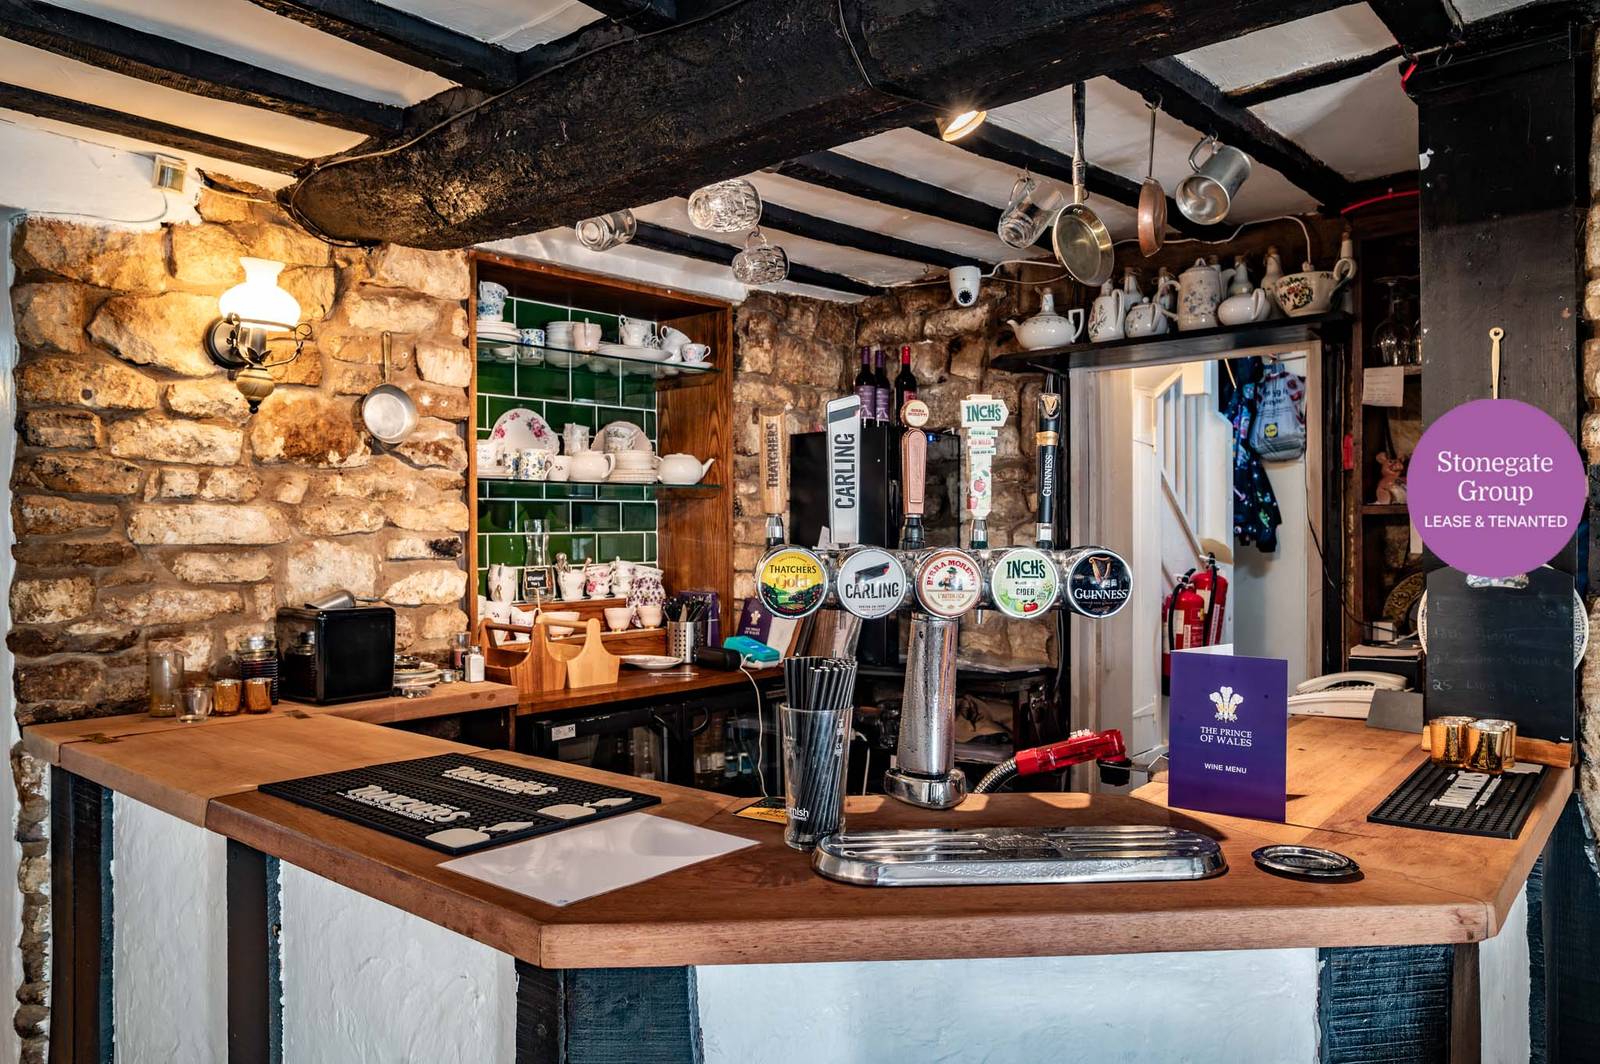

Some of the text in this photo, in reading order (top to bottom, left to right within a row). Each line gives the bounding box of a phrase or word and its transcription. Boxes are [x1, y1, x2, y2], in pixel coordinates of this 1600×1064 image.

[766, 423, 779, 490] THATCHERS
[834, 433, 855, 509] CARLING
[1043, 454, 1054, 497] GUINNESS
[770, 565, 817, 574] THATCHERS
[776, 573, 808, 589] Gold
[845, 582, 899, 599] CARLING
[1016, 588, 1035, 596] CIDER
[1074, 588, 1128, 600] GUINNESS
[1200, 726, 1252, 739] THE PRINCE
[1200, 734, 1252, 747] OF WALES
[1204, 763, 1247, 774] WINE MENU
